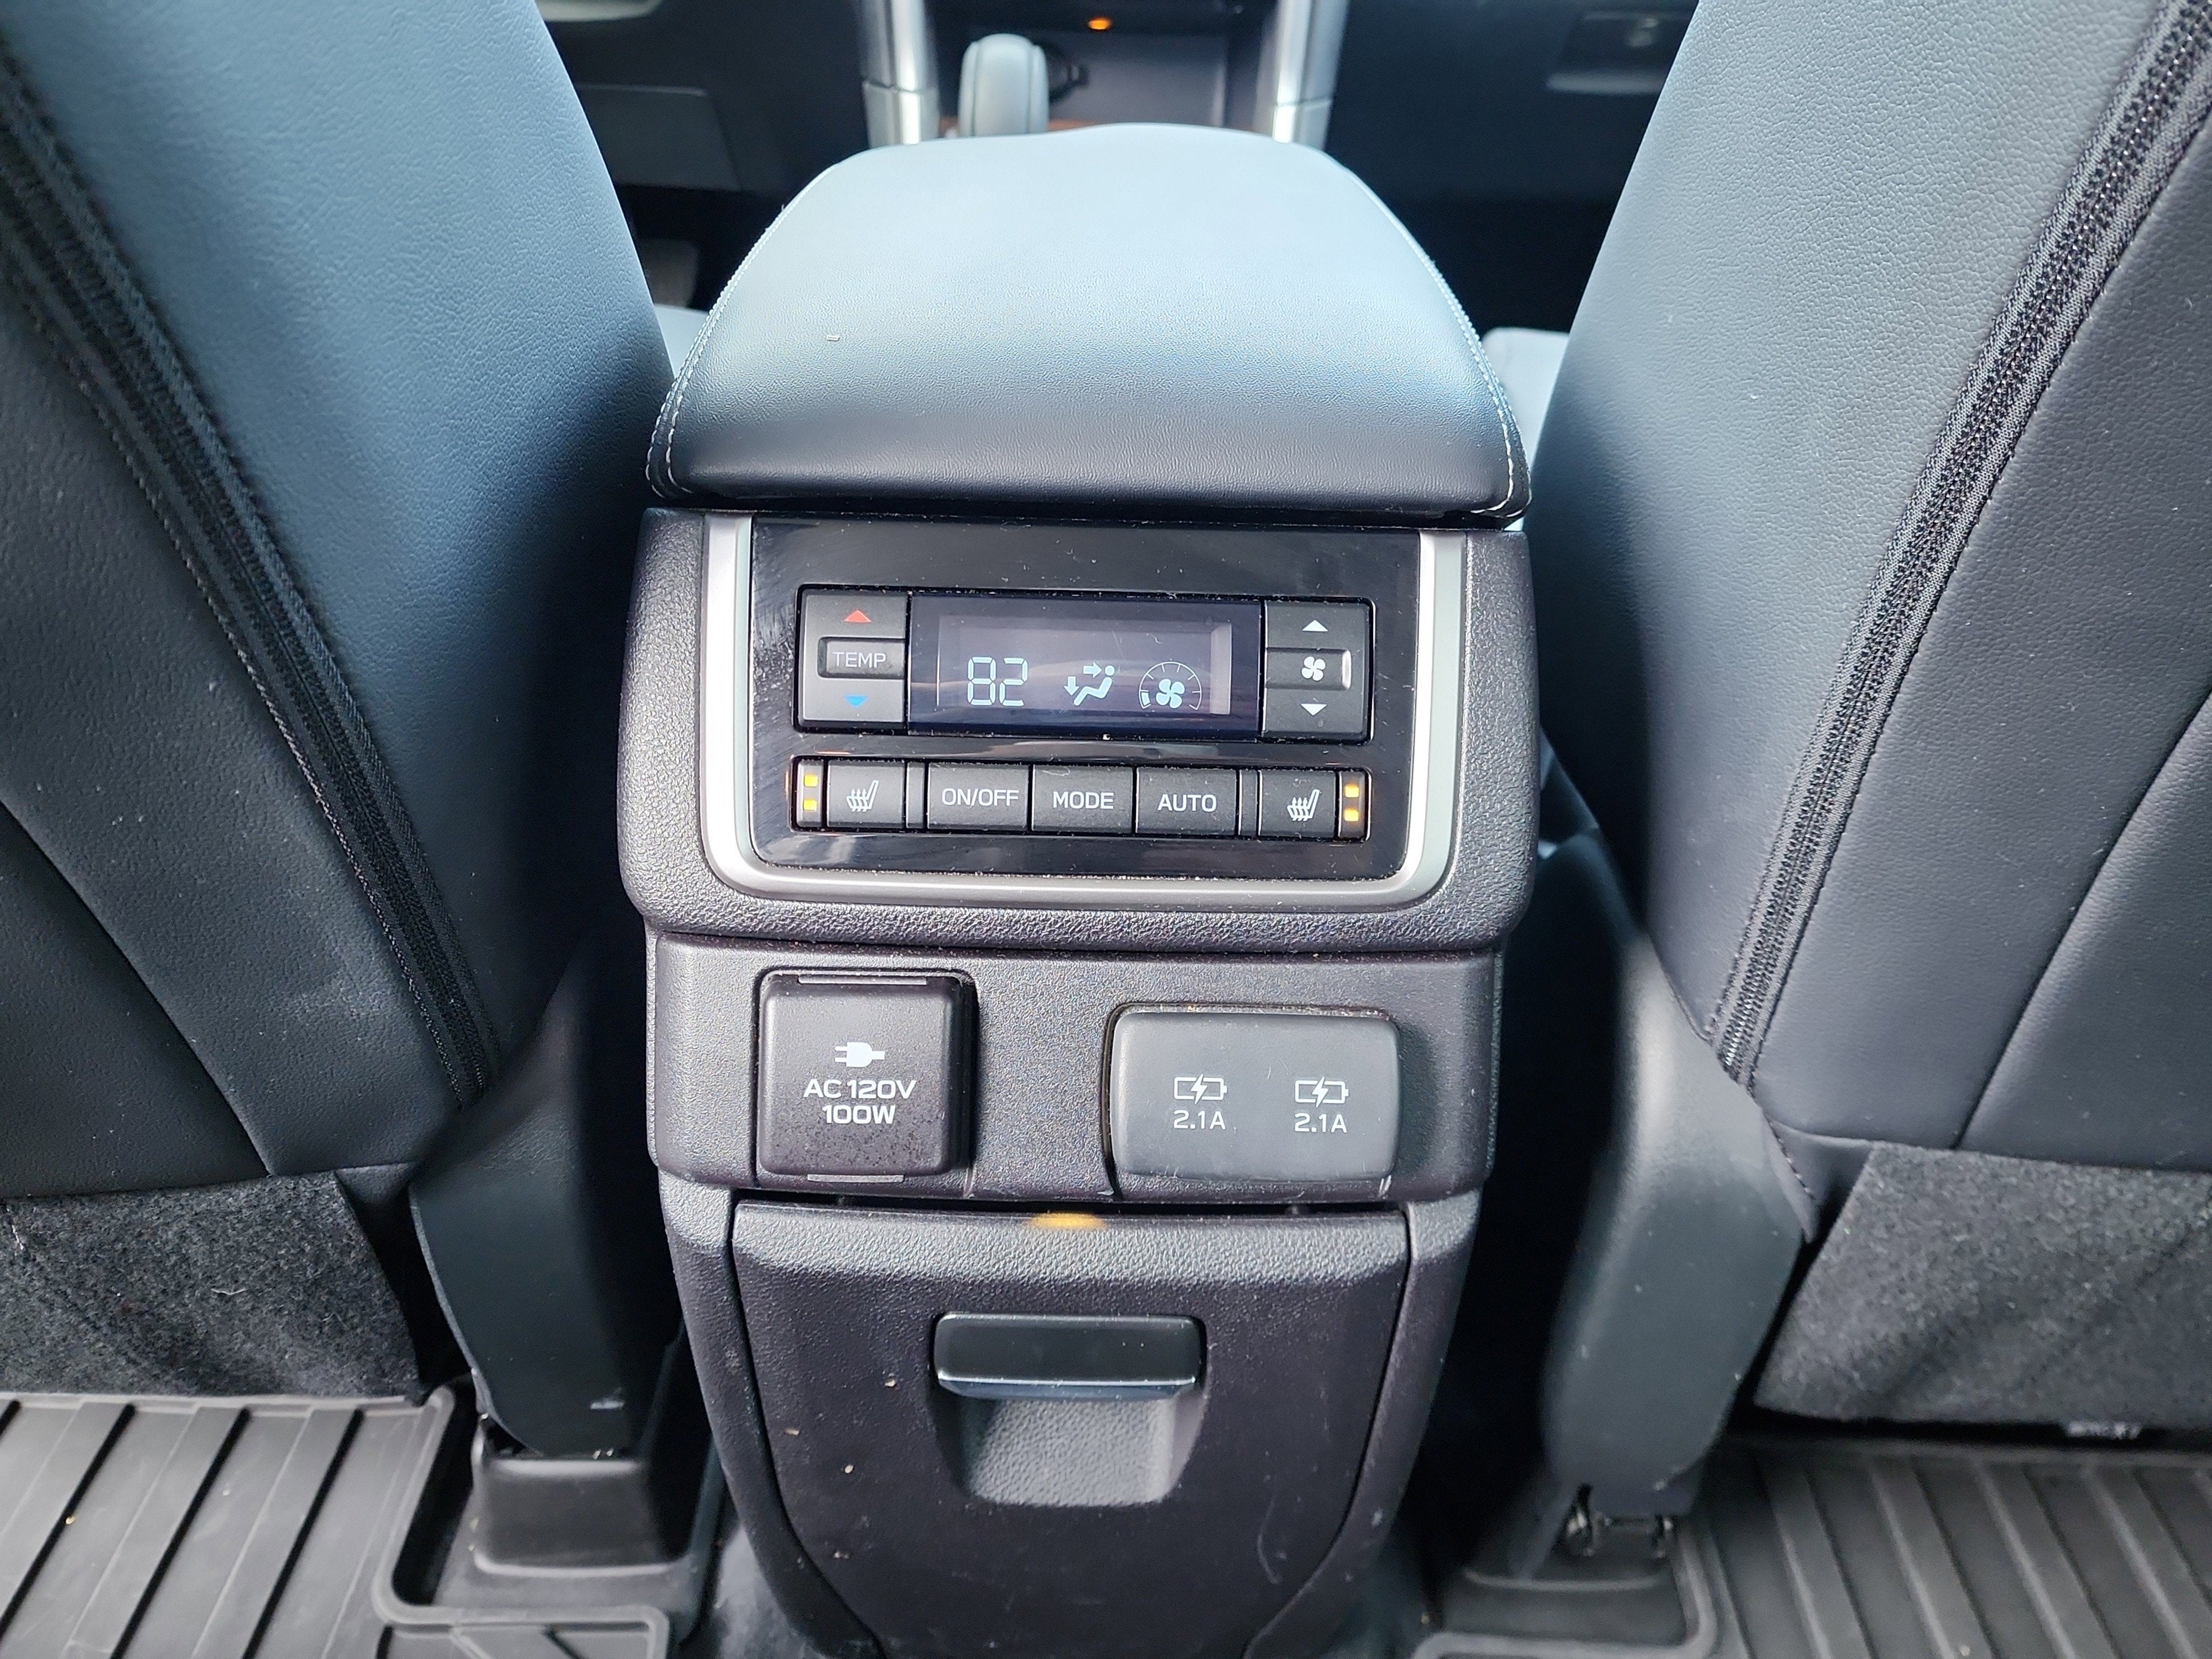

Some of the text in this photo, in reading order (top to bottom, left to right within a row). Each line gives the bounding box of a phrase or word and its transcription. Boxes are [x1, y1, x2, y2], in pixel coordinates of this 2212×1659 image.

[832, 651, 886, 668] TEMP
[967, 656, 1028, 706] 82
[942, 788, 1019, 806] ON/OFF
[1053, 791, 1114, 809] MODE
[1157, 794, 1217, 812] AUTO
[803, 1078, 916, 1099] AC 120V
[822, 1103, 895, 1124] 100W
[1173, 1110, 1226, 1130] 2.1A
[1295, 1113, 1347, 1133] 2.1A
